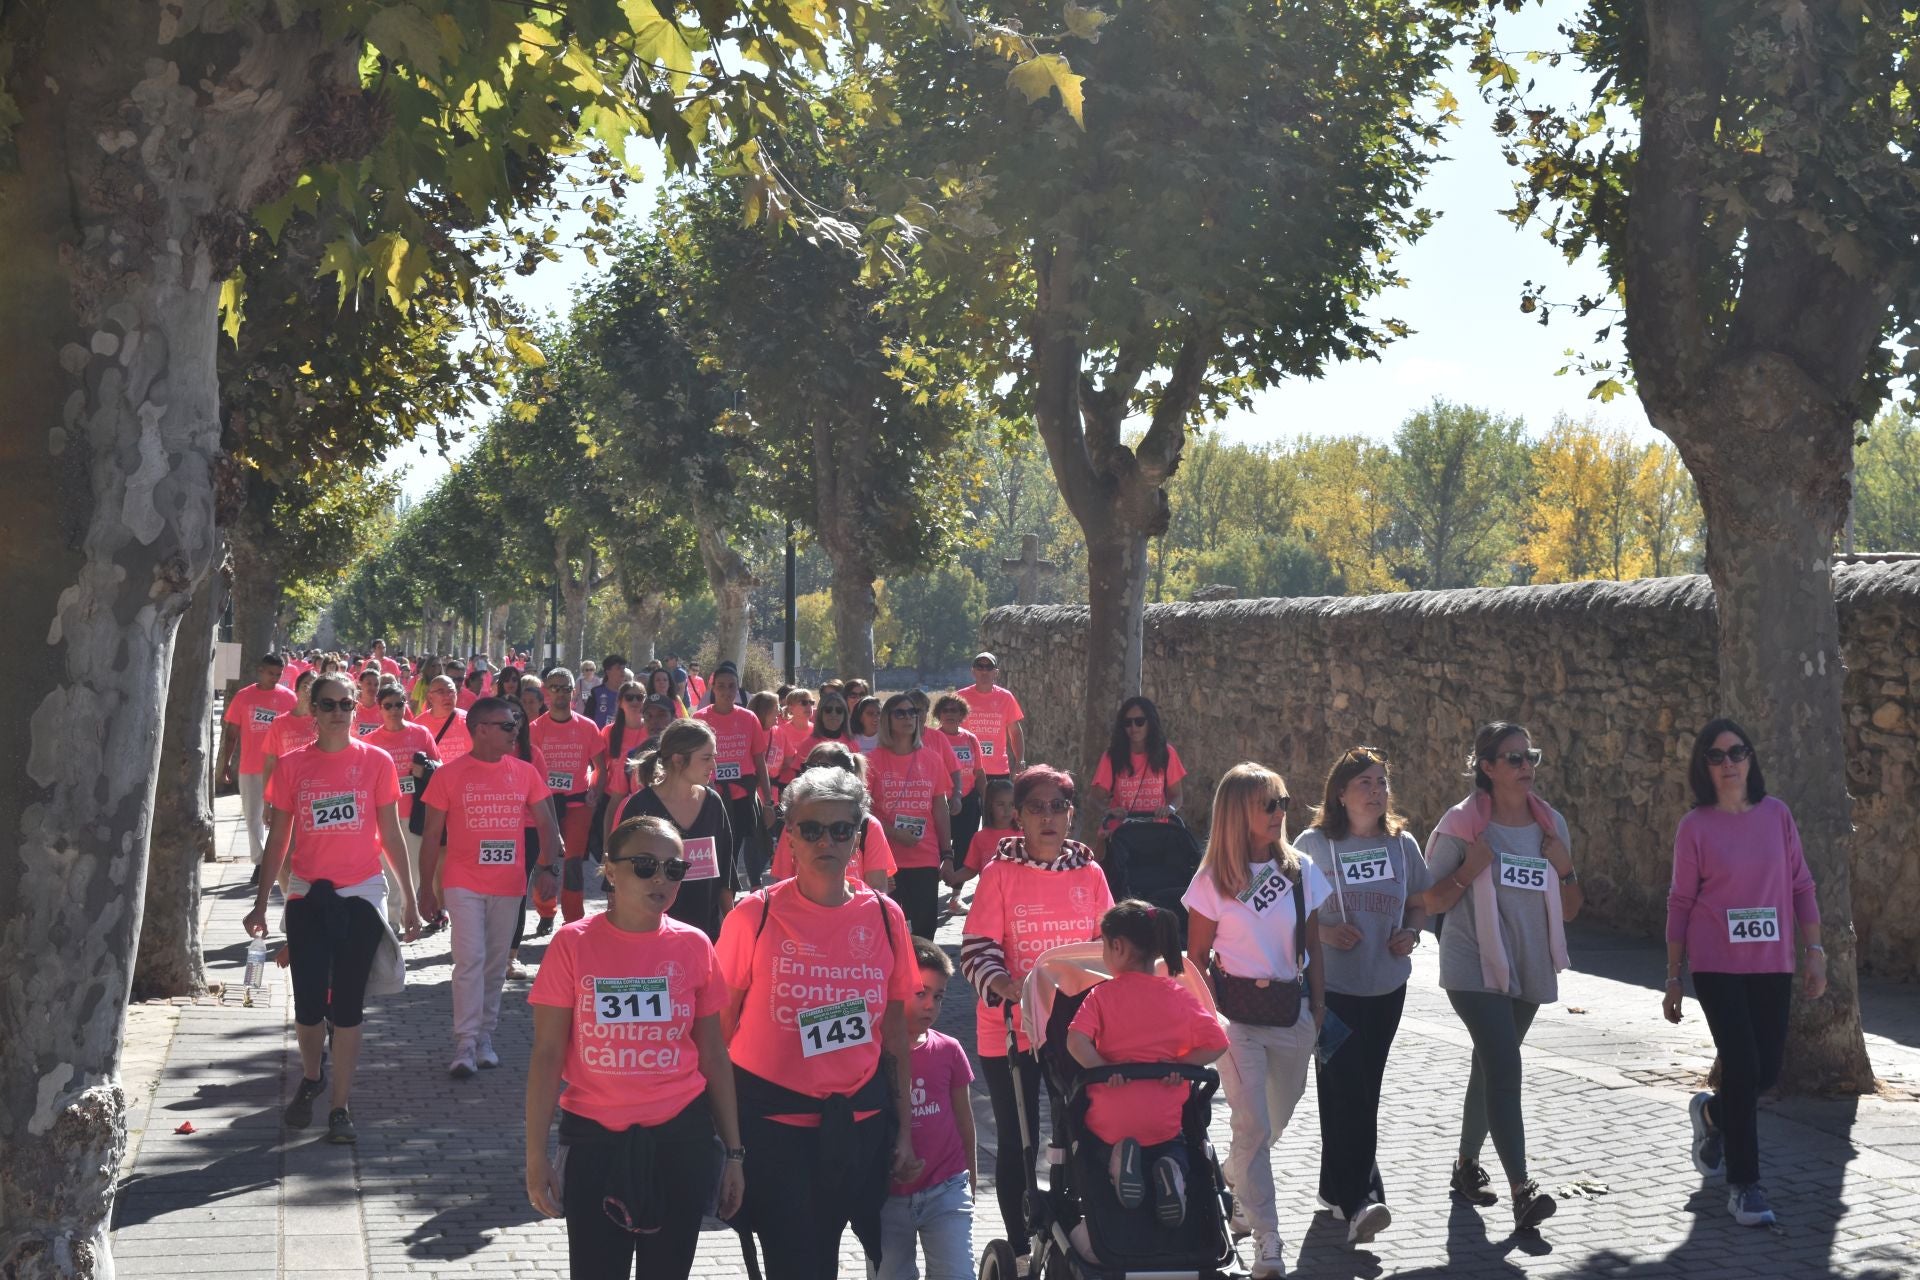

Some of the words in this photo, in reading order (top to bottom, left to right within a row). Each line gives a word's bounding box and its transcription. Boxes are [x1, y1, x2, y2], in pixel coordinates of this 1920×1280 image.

[716, 749, 746, 759] áncer
[549, 777, 571, 788] 354
[717, 768, 739, 778] 203
[301, 790, 316, 800] En
[466, 792, 480, 802] En
[316, 804, 355, 825] 240
[467, 803, 510, 815] contra
[482, 849, 513, 862] 335
[688, 847, 711, 861] 444
[1346, 860, 1387, 880] 457
[1503, 866, 1544, 887] 455
[1252, 875, 1287, 913] 459
[1017, 919, 1039, 934] En
[1043, 915, 1095, 931] march
[1732, 920, 1776, 939] 460
[779, 957, 805, 976] En
[811, 963, 884, 980] marcha
[776, 982, 860, 1003] contra
[865, 984, 884, 1004] el
[601, 993, 662, 1019] 311
[582, 1021, 662, 1041] contra
[666, 1021, 687, 1041] el
[807, 1017, 866, 1050] 143
